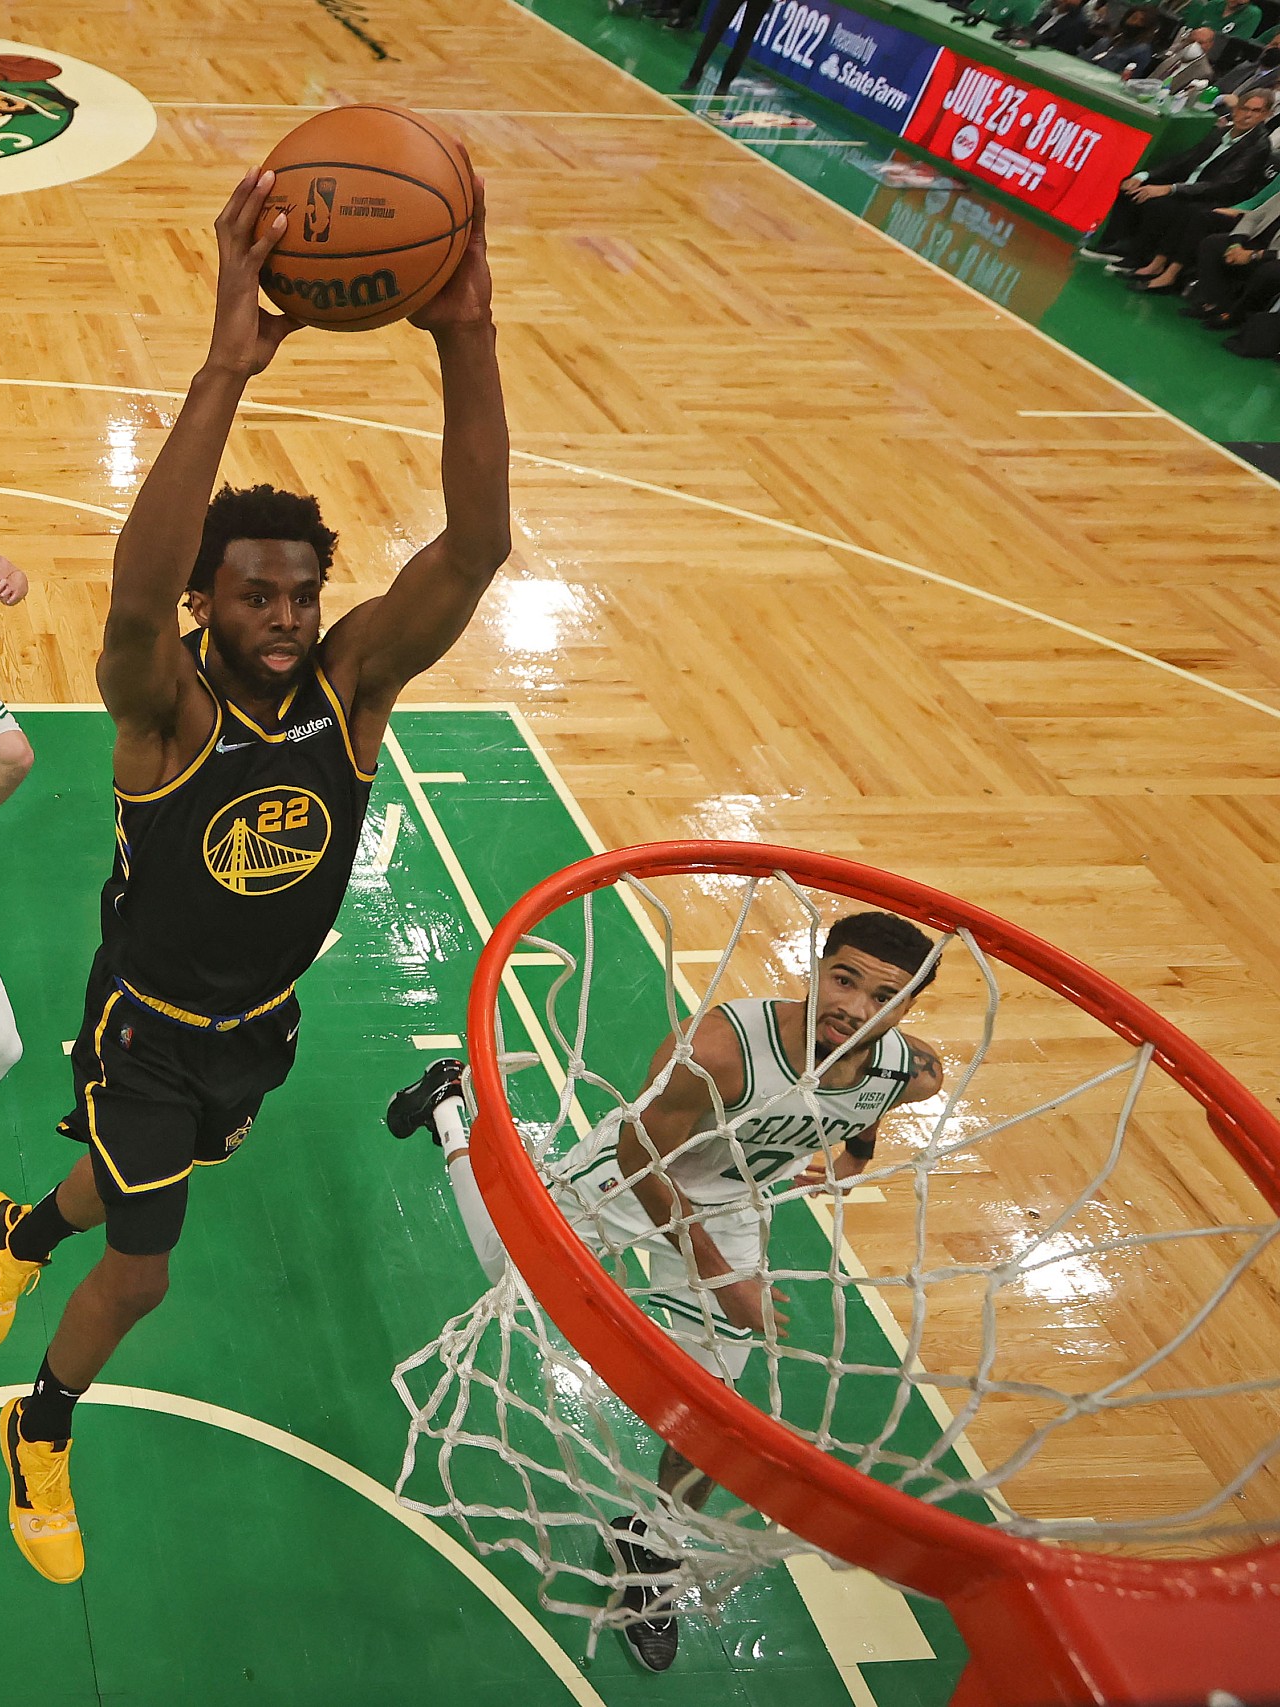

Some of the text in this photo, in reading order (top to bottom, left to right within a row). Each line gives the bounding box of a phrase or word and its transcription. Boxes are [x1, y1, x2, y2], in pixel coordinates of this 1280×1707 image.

[771, 1, 830, 69] 2022
[943, 67, 1003, 125] JUNE
[984, 85, 1028, 136] 23
[1025, 103, 1057, 150] 8
[976, 141, 1047, 191] ESPN
[285, 717, 333, 742] akuten
[257, 796, 310, 833] 22
[854, 1102, 881, 1110] PRINT
[859, 1092, 886, 1102] VISTA
